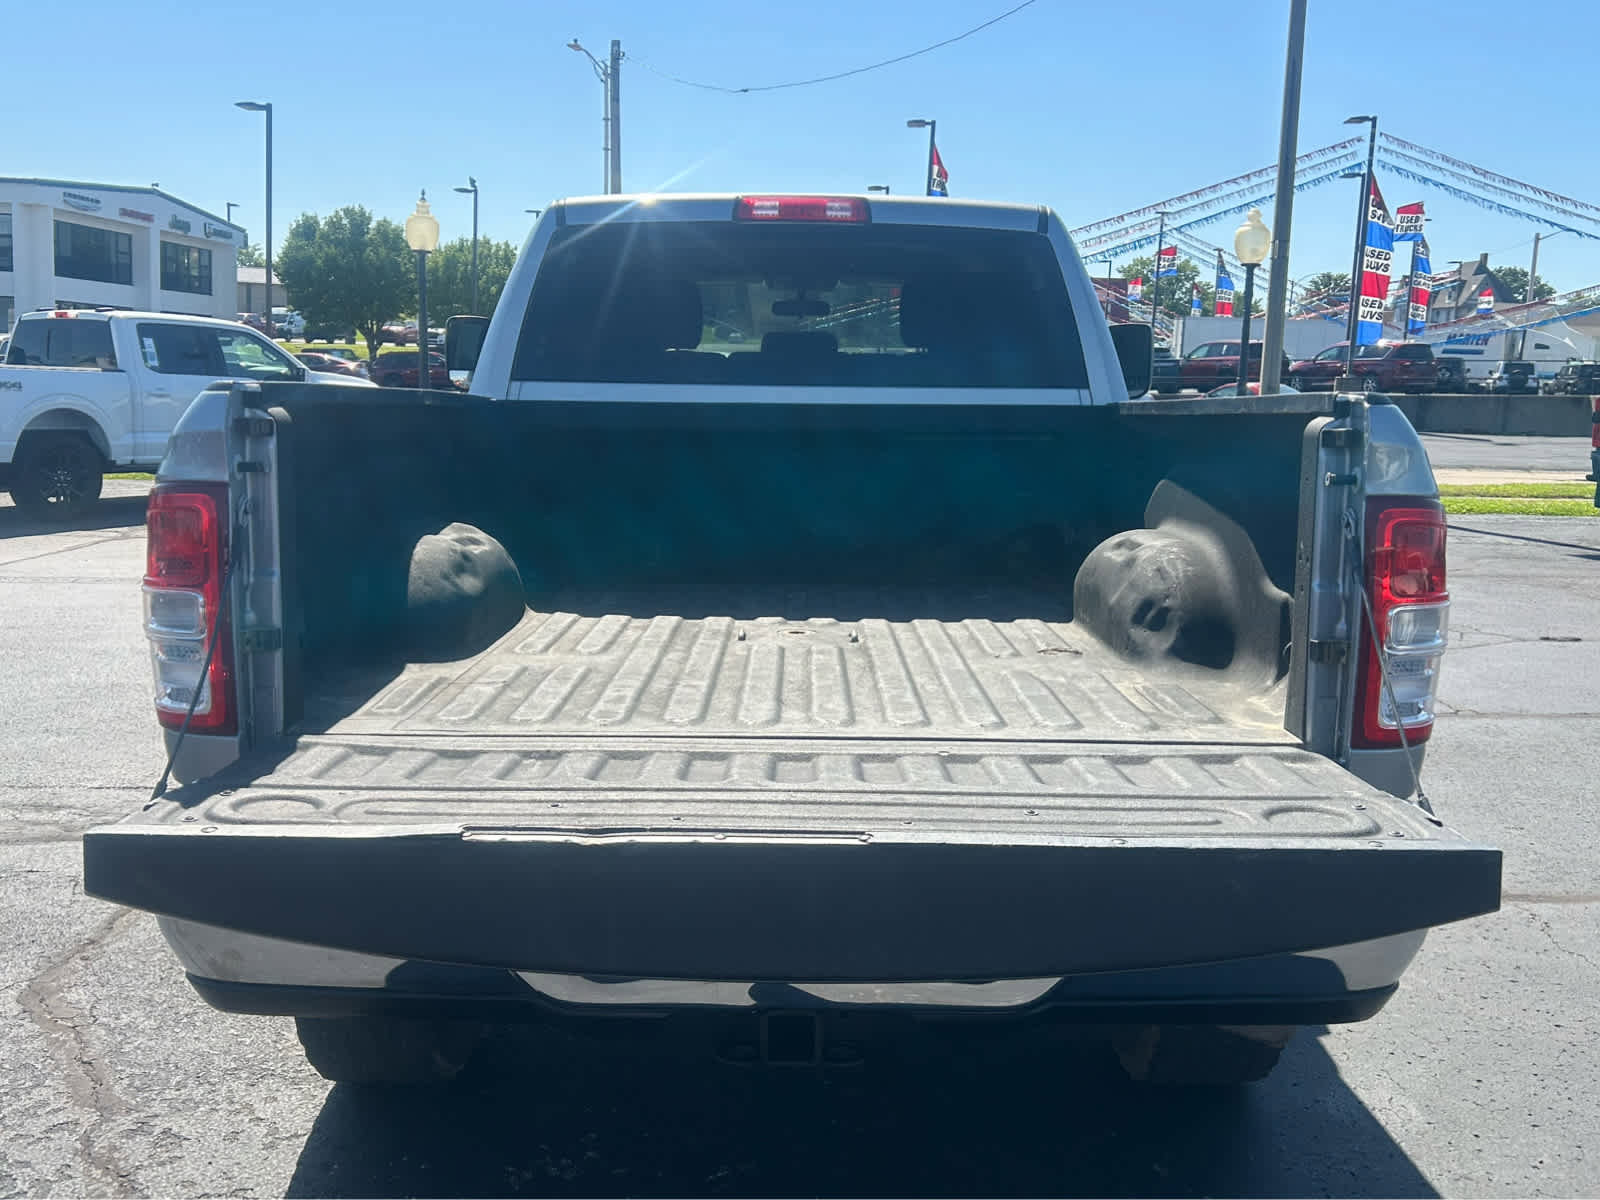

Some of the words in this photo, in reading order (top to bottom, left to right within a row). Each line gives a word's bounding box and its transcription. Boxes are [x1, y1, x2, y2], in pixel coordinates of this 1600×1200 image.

[1399, 215, 1420, 224] USED
[1395, 223, 1424, 233] TRUCKS
[1365, 248, 1391, 261] USED
[1360, 309, 1383, 321] UVS
